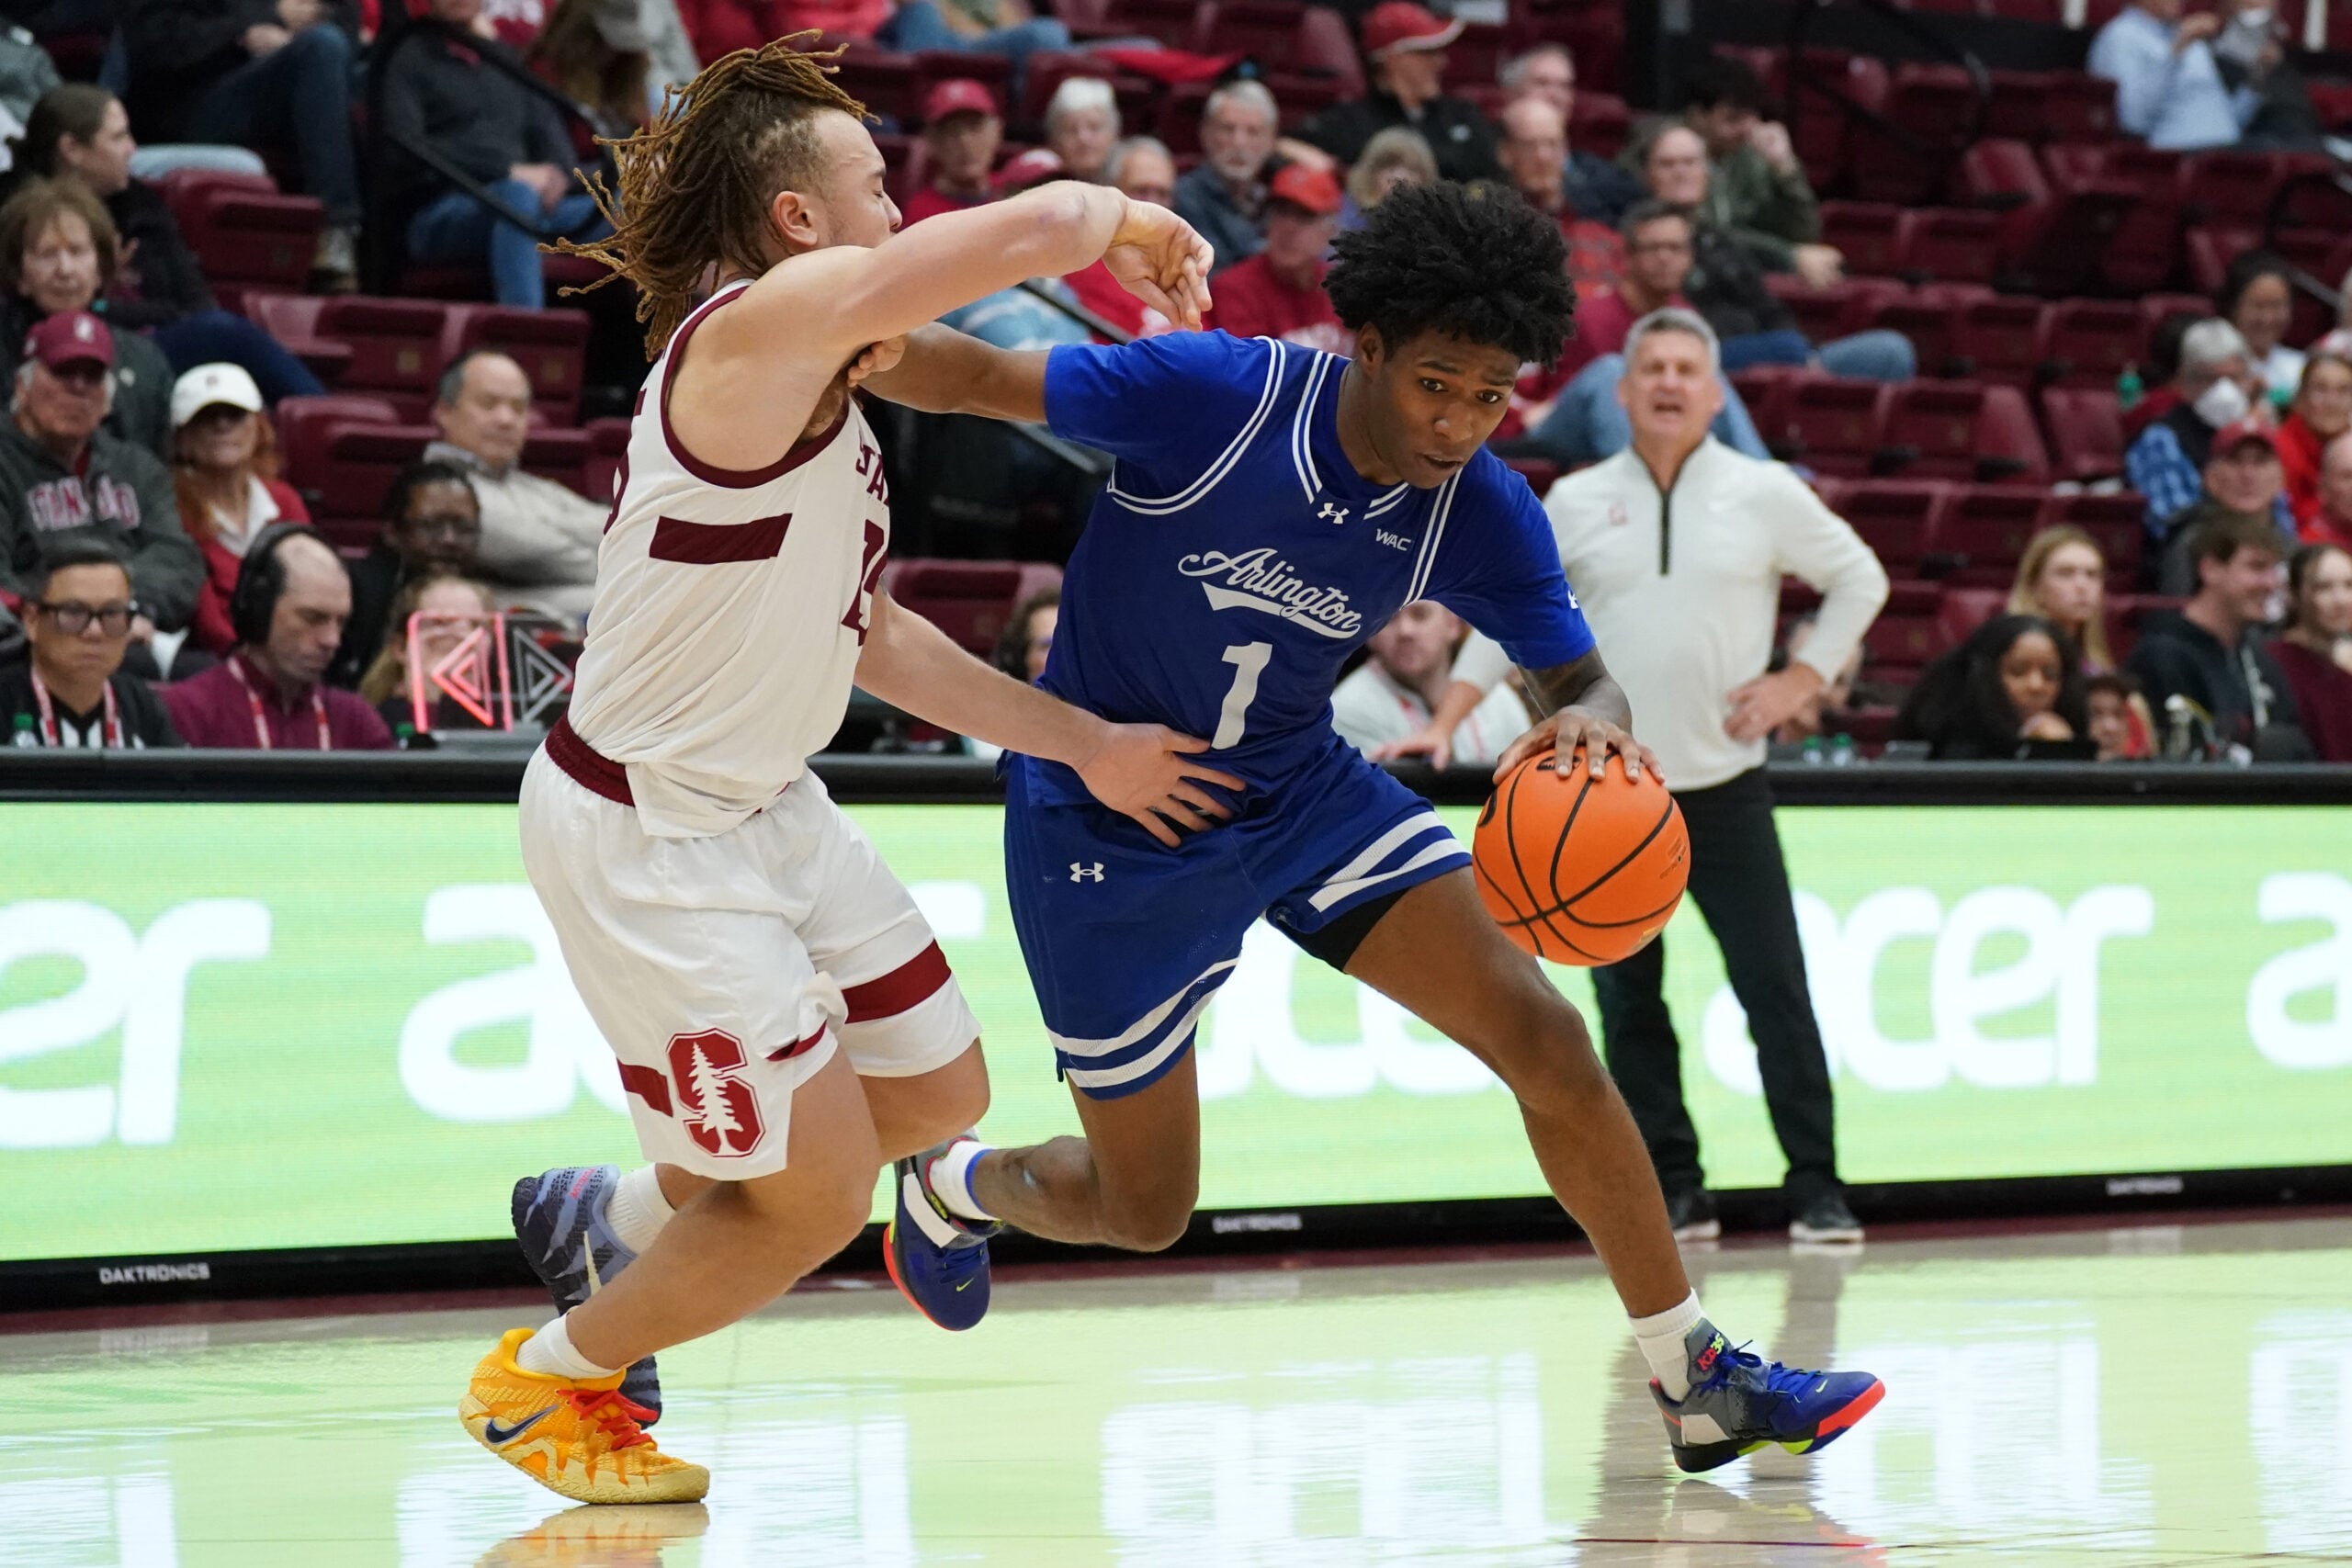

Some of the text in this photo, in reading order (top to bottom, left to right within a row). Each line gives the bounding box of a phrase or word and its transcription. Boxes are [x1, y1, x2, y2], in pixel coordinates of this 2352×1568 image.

[1375, 528, 1412, 551] WAC
[1178, 547, 1363, 630] Arlington
[1211, 641, 1273, 750] 1
[99, 1262, 210, 1284] DAKTRONICS
